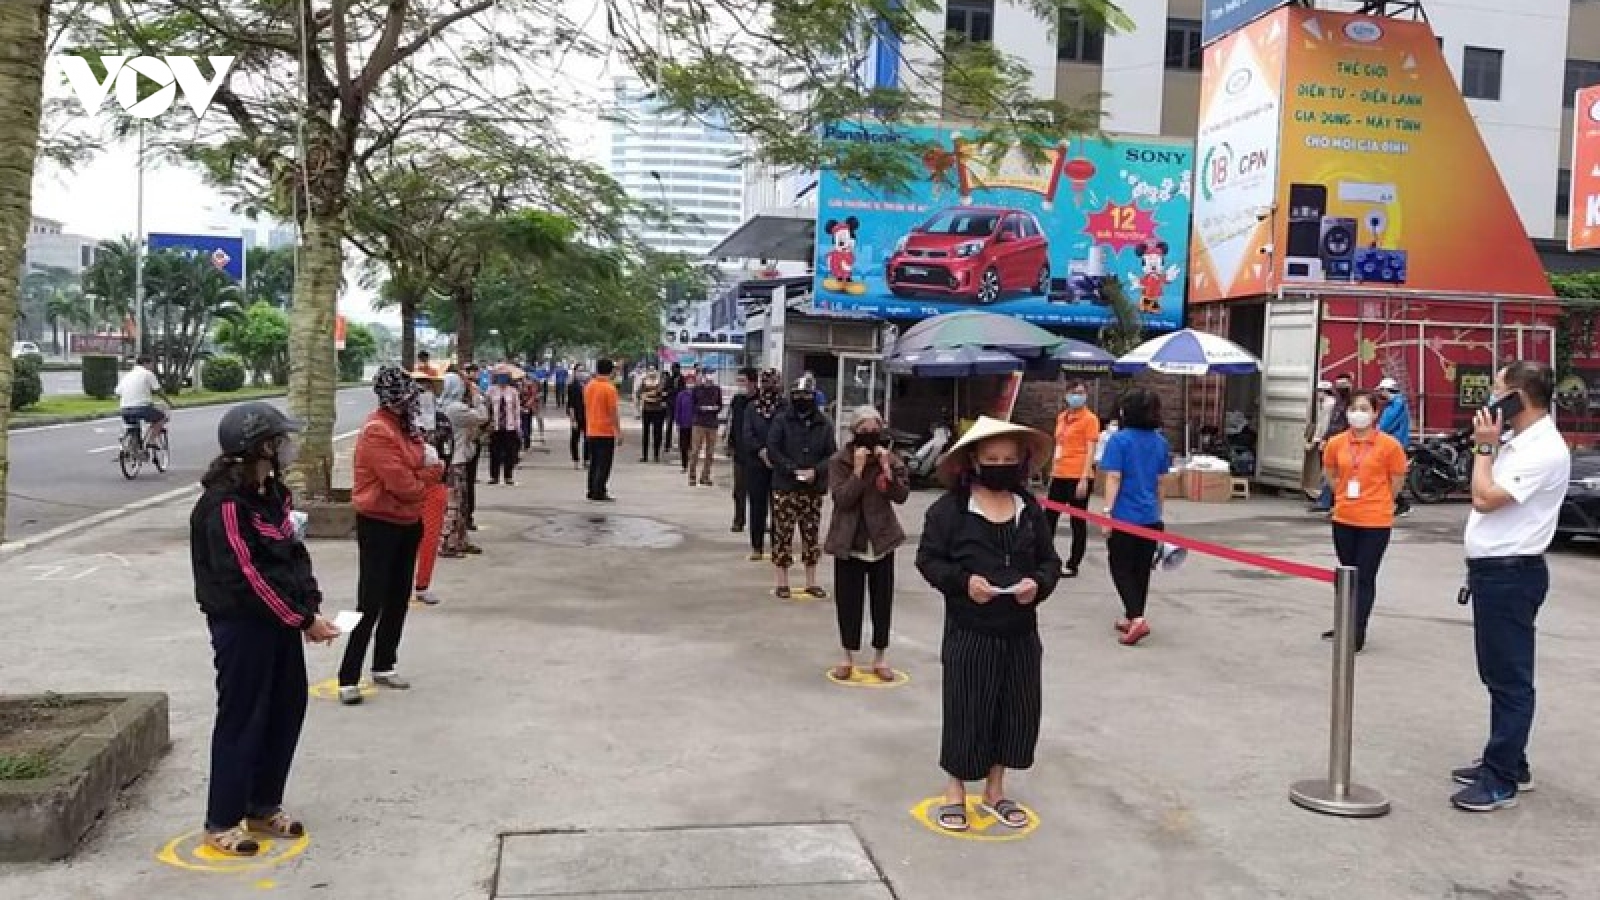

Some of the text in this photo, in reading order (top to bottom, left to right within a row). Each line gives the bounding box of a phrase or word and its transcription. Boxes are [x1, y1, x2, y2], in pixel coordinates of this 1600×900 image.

[1125, 148, 1187, 165] SONY
[1238, 148, 1269, 175] CPN
[1109, 206, 1137, 231] 12
